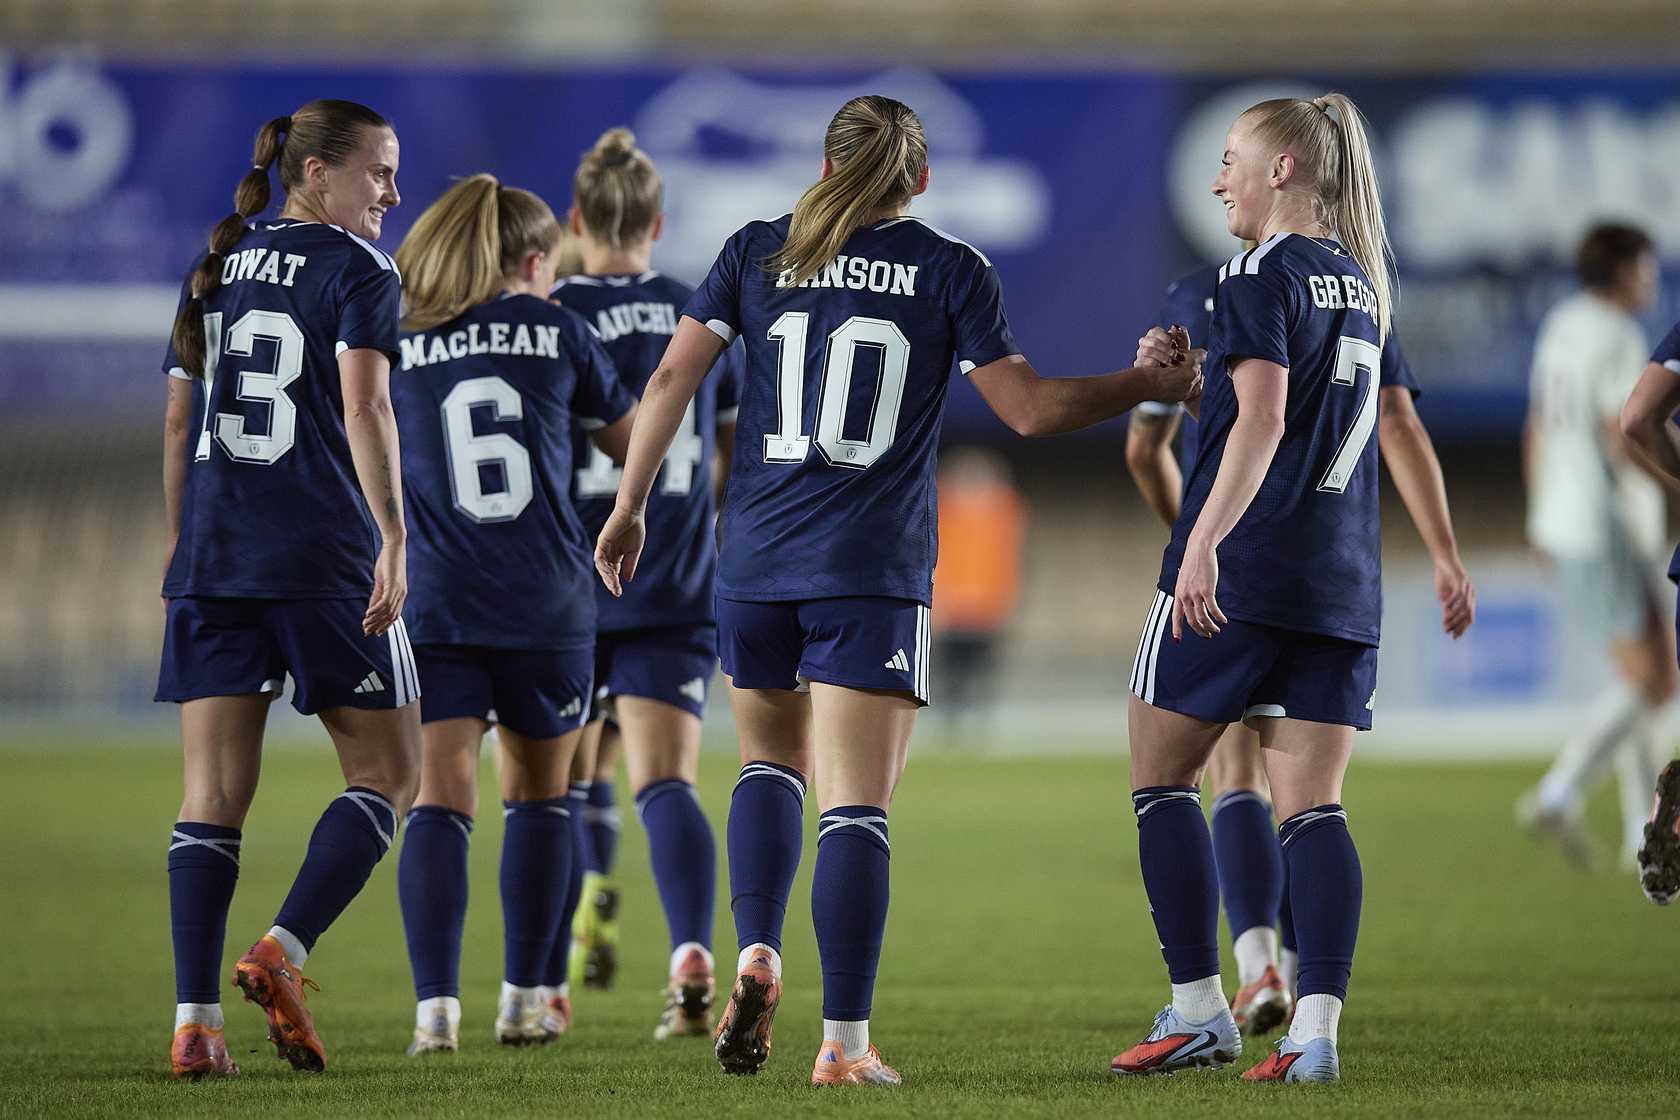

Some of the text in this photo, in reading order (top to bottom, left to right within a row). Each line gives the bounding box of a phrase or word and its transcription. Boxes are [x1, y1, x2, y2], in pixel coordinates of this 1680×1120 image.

[220, 248, 307, 288] OWAT
[440, 375, 534, 525] 6
[763, 311, 911, 471] 10
[1316, 335, 1381, 494] 7
